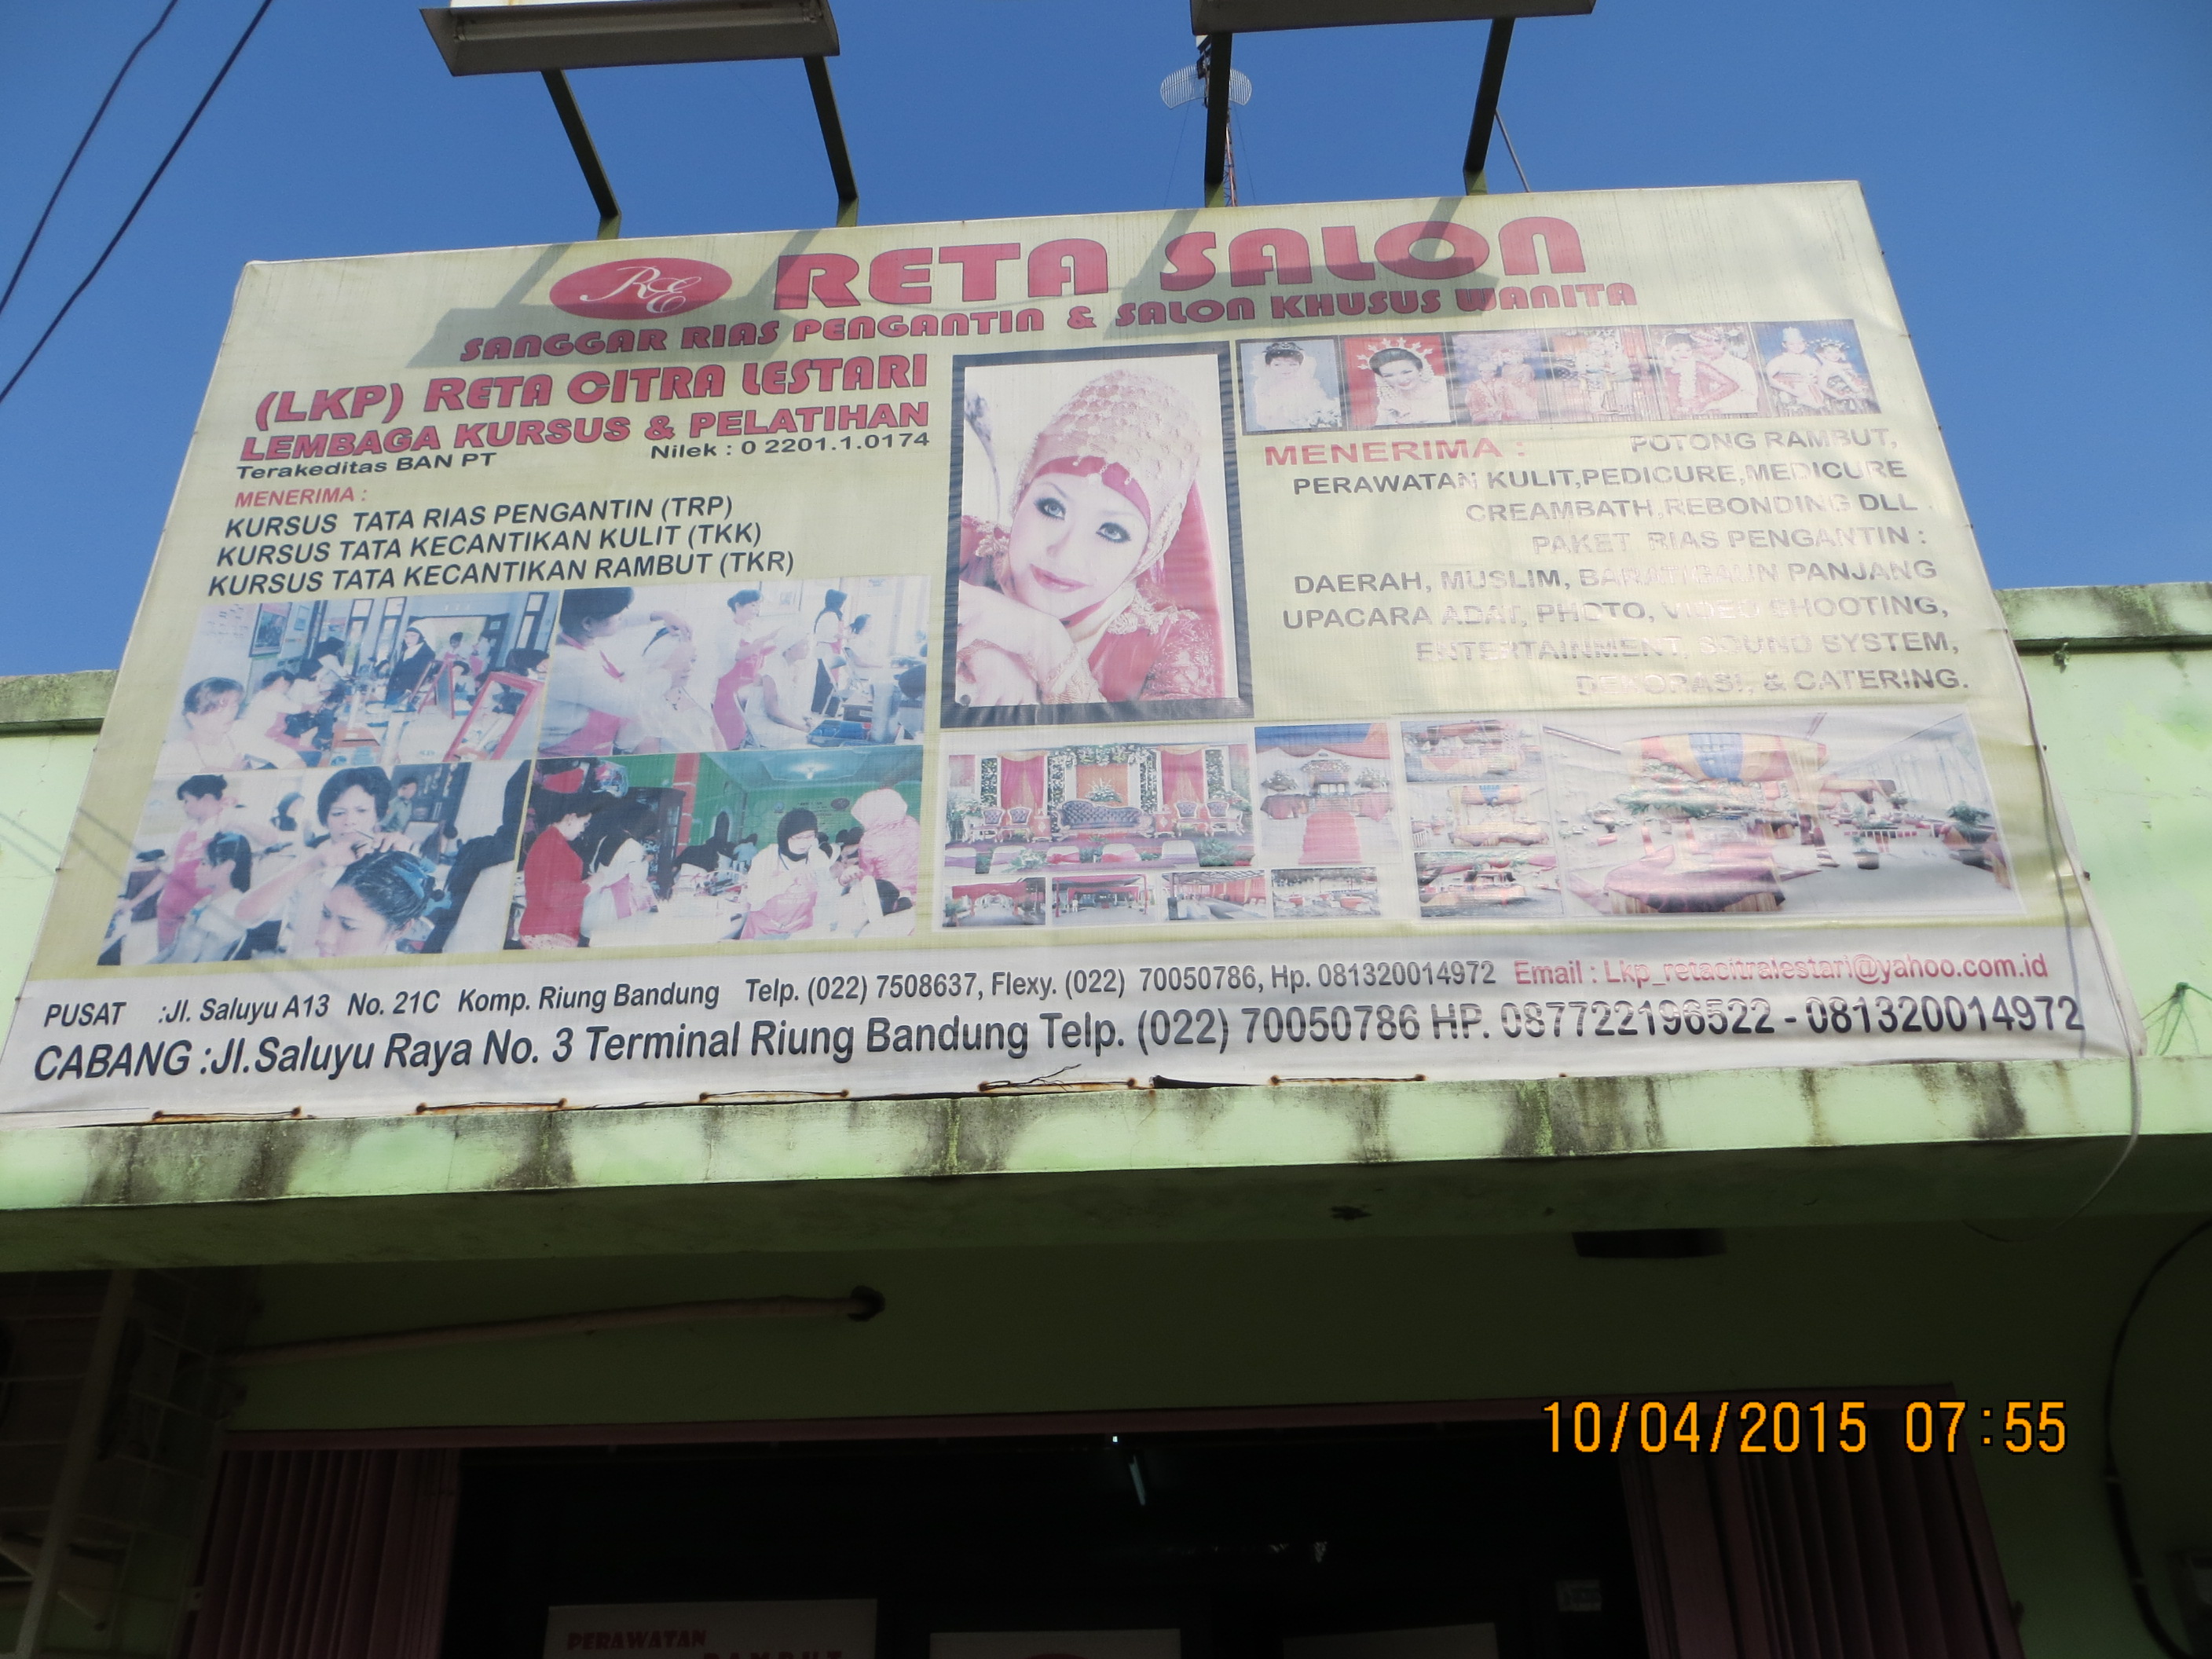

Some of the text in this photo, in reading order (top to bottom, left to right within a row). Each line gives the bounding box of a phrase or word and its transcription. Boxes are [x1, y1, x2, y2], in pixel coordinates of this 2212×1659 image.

[774, 216, 1587, 310] RETA SALON
[460, 282, 1637, 362] SANGGAR RIAS PENGANTIN & SALON KHUSUS WANITA
[255, 353, 928, 431] (LKP) RETA CITRA LESTARI
[240, 401, 929, 461] LEMBAGA KURSUS & PELATIHAN
[651, 443, 717, 460] Nilek
[764, 432, 930, 453] 2201.1.0174
[1632, 429, 1898, 452] POTONG RAMBUT,
[236, 452, 497, 480] Terakeditas BAN PT
[1265, 438, 1503, 466] MENERIMA
[235, 486, 355, 507] MENERIMA
[1293, 473, 1477, 495] PERAWATAN
[225, 496, 733, 538] KURSUS TATA RIAS PENGANTIN (TRP)
[217, 522, 761, 566] KURSUS TATA KECANTIKAN KULIT (TKK)
[1533, 533, 1629, 555] PAKET
[1648, 530, 1719, 550] RIAS
[1728, 526, 1909, 548] PENGANTIN
[209, 551, 794, 595] KURSUS TATA KECANTIKAN RAMBUT (TKR)
[1295, 572, 1431, 594] DAERAH,
[1441, 569, 1570, 591] MUSLIM,
[1788, 559, 1937, 583] PANJANG
[1283, 596, 1948, 629] UPACARA ADAT, PHOTO, VIDEO SHOOTING,
[1416, 632, 1959, 661] ENTERTAINMENT, SOUND SYSTEM,
[1763, 672, 1788, 691] &
[1794, 668, 1968, 690] CATERING.
[44, 1001, 126, 1029] PUSAT
[199, 994, 281, 1027] Saluyu
[282, 993, 330, 1020] A13
[347, 991, 386, 1018] No.
[391, 989, 440, 1016] 21C
[458, 987, 530, 1019] Komp.
[539, 983, 606, 1015] Riung
[613, 981, 720, 1012] Bandung
[746, 977, 799, 1007] Telp.
[808, 975, 869, 1005] (022)
[875, 972, 983, 1002] 7508637,
[991, 970, 1058, 1002] Flexy.
[1064, 967, 1126, 998] (022)
[1139, 965, 1264, 994] 70050786,
[1272, 964, 1312, 993] Hp.
[1317, 960, 1496, 988] 081320014972
[1513, 958, 1584, 986] Email
[33, 1037, 190, 1082] CABANG
[384, 1027, 471, 1075] Raya
[482, 1026, 540, 1066] No.
[552, 1025, 573, 1064] 3
[585, 1019, 738, 1060] Terminal
[750, 1016, 855, 1064] Riung
[866, 1013, 1028, 1060] Bandung
[1038, 1010, 1126, 1058] Telp.
[1137, 1006, 1230, 1057] (022)
[1241, 1002, 1420, 1045] 70050786
[1431, 1002, 1490, 1042] HP.
[1500, 998, 1775, 1040] 087722196522
[1805, 994, 2083, 1035] 081320014972
[567, 1630, 707, 1650] PERAWATAN
